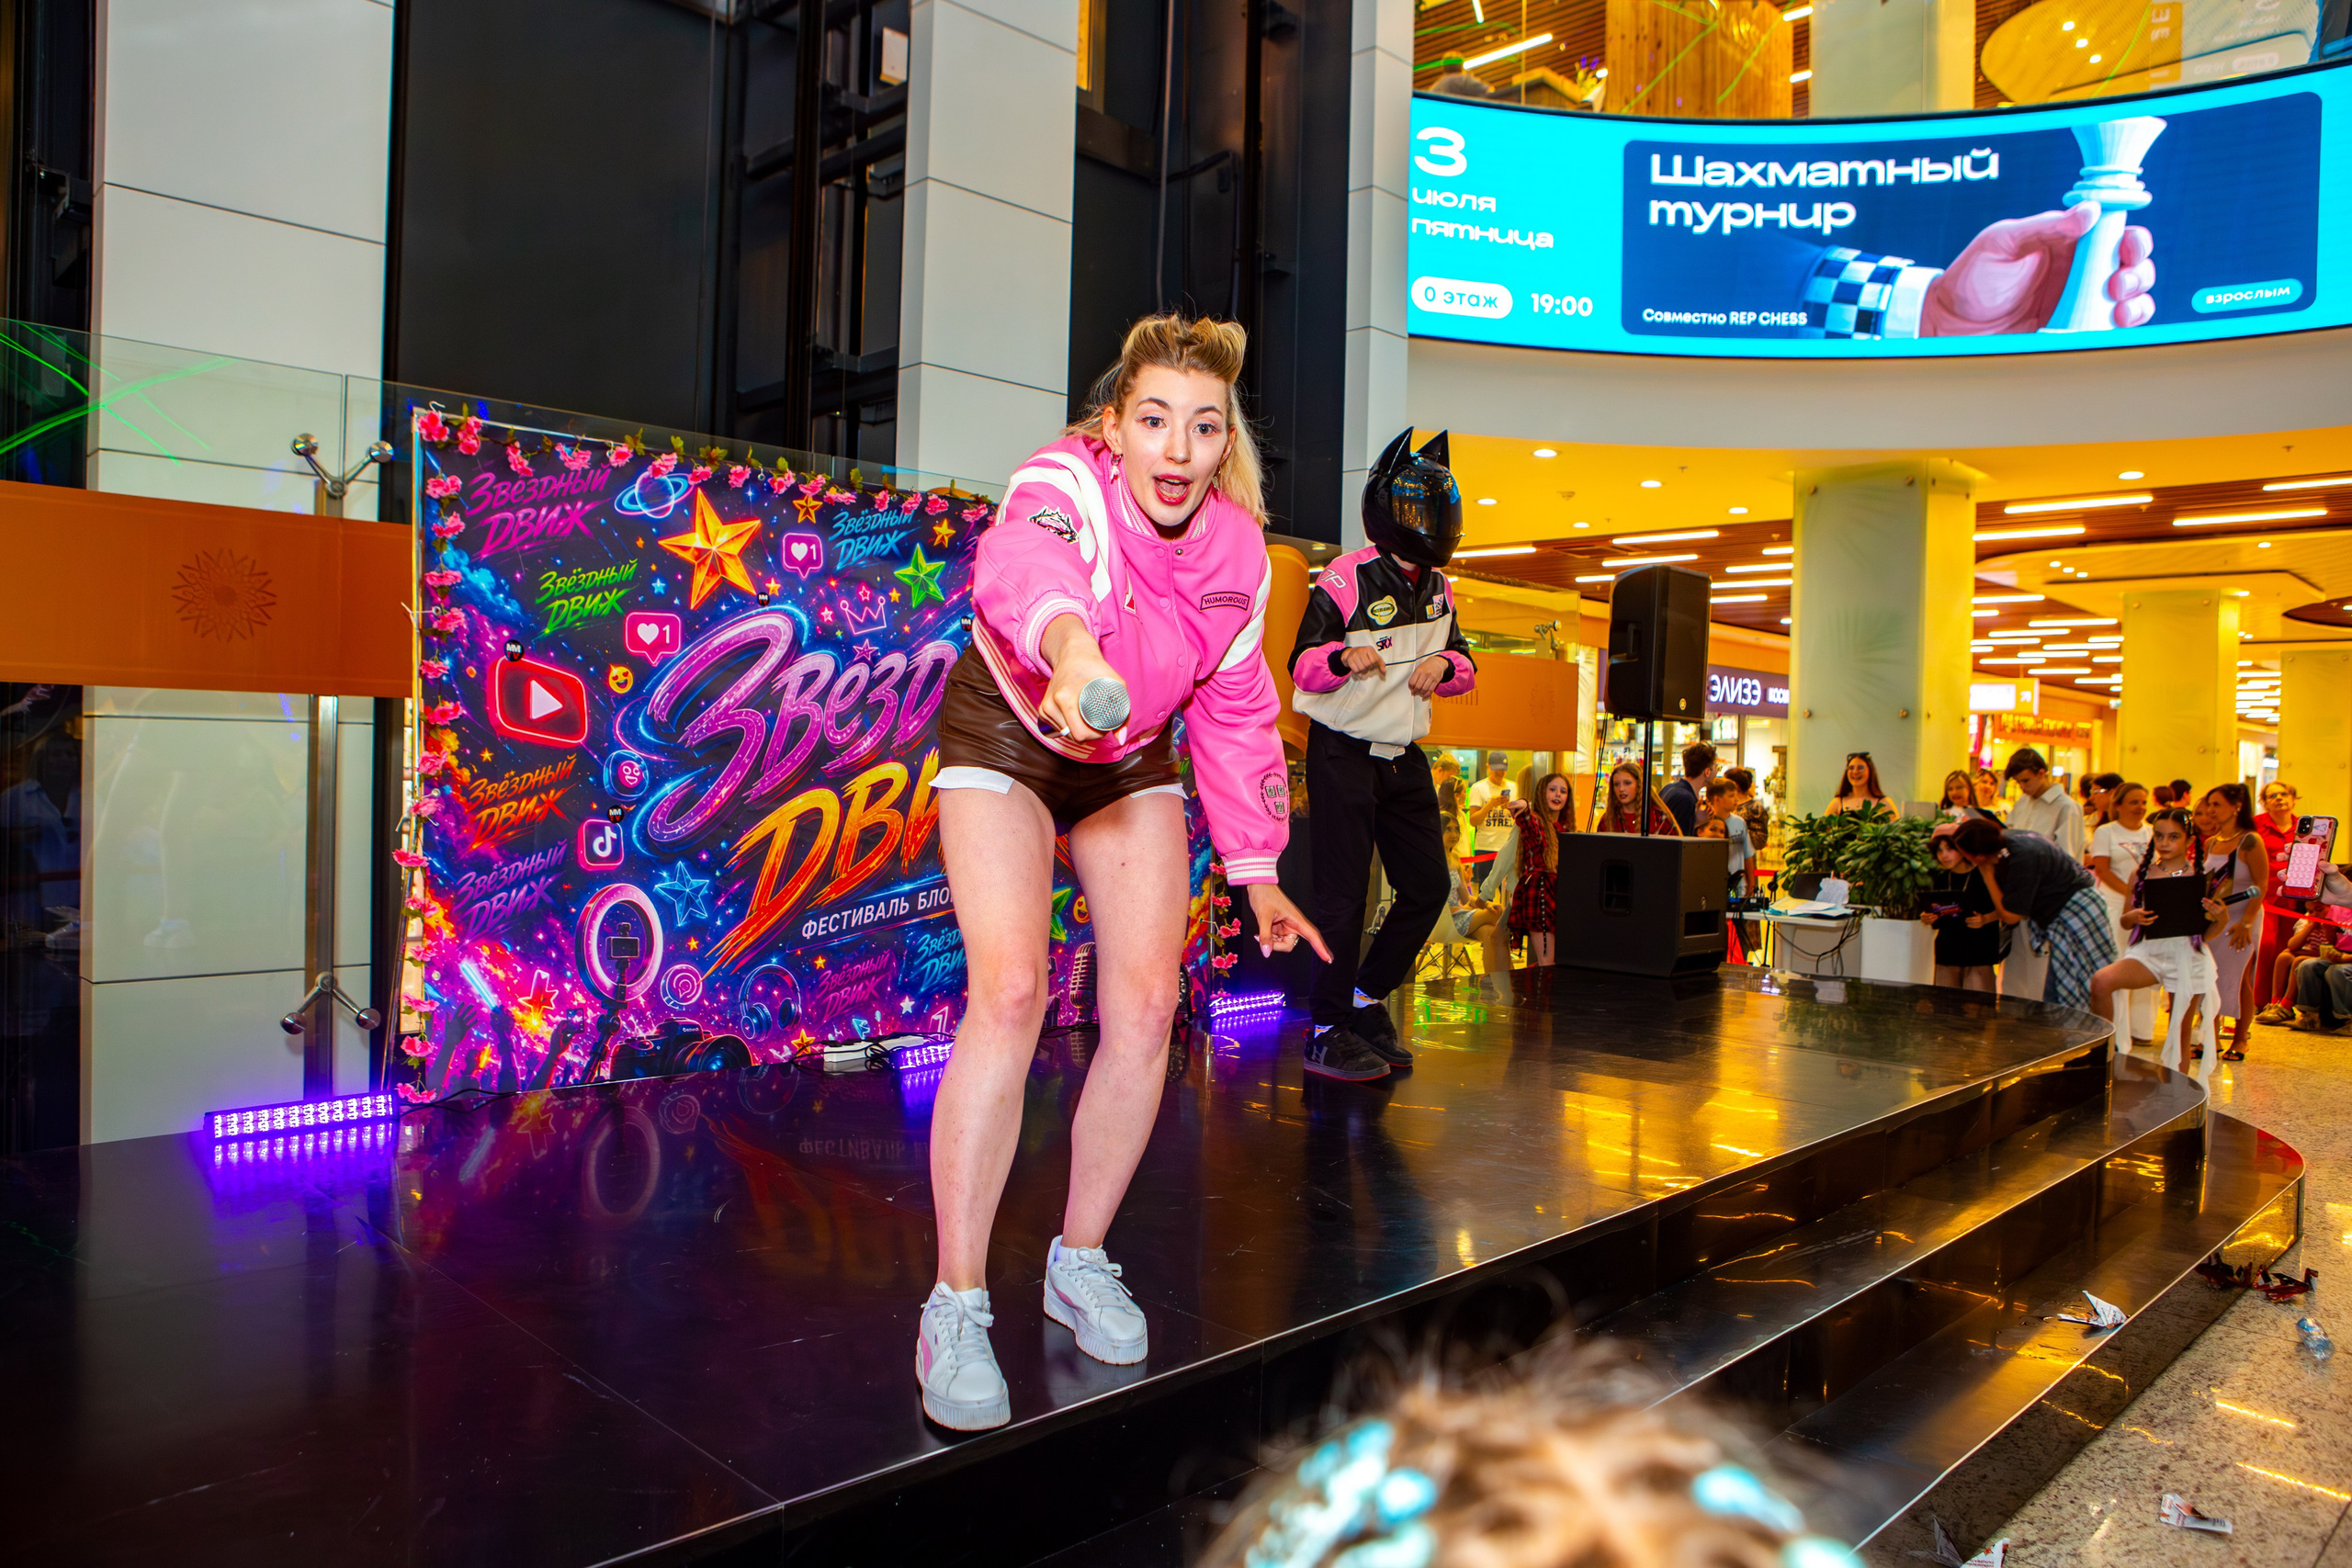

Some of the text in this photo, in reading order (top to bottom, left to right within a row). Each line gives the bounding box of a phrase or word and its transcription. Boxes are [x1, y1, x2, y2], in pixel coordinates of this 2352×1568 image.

[1414, 127, 1467, 176] 3
[1650, 147, 1999, 187] Шахматный
[1412, 187, 1497, 212] июля
[1649, 199, 1856, 235] турнир
[1411, 218, 1555, 251] пятница
[1424, 287, 1498, 309] 0 этаж
[1531, 292, 1593, 317] 19:00
[2206, 287, 2290, 304] взрослым
[1643, 308, 1807, 325] Совместно REP CHESS
[810, 545, 817, 559] 1
[1204, 596, 1248, 604] HUMOROUS
[662, 625, 670, 644] 1
[1709, 673, 1761, 706] ЭЛИЗЭ
[702, 747, 944, 979] ДВИ
[802, 886, 954, 940] ФЕСТИВАЛЬ БЛО
[917, 949, 967, 992] ДВИ
